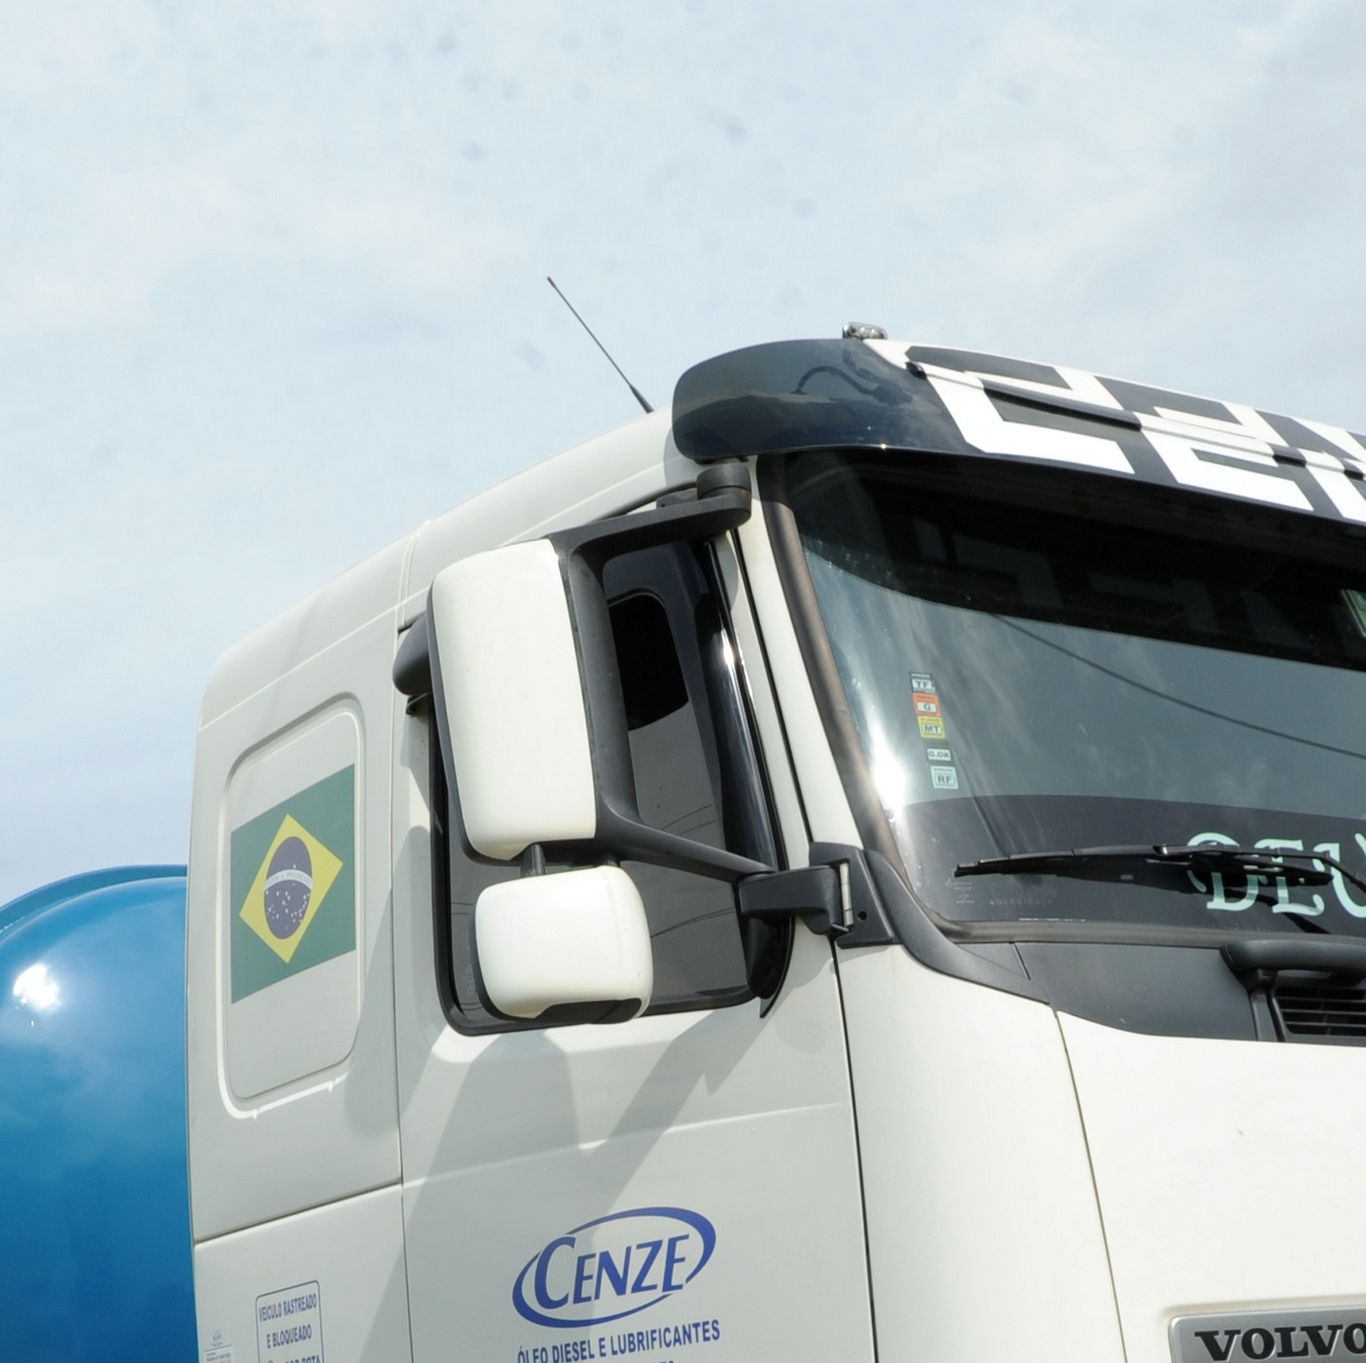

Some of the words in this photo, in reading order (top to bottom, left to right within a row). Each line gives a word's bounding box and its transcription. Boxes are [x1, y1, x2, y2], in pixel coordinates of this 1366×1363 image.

[535, 1233, 690, 1310] CENZE
[283, 1293, 318, 1316] RASTREADO
[266, 1333, 272, 1349] E
[272, 1324, 313, 1348] BLOQUEADO
[598, 1337, 607, 1358] E
[610, 1319, 721, 1356] LUBRIFICANTES
